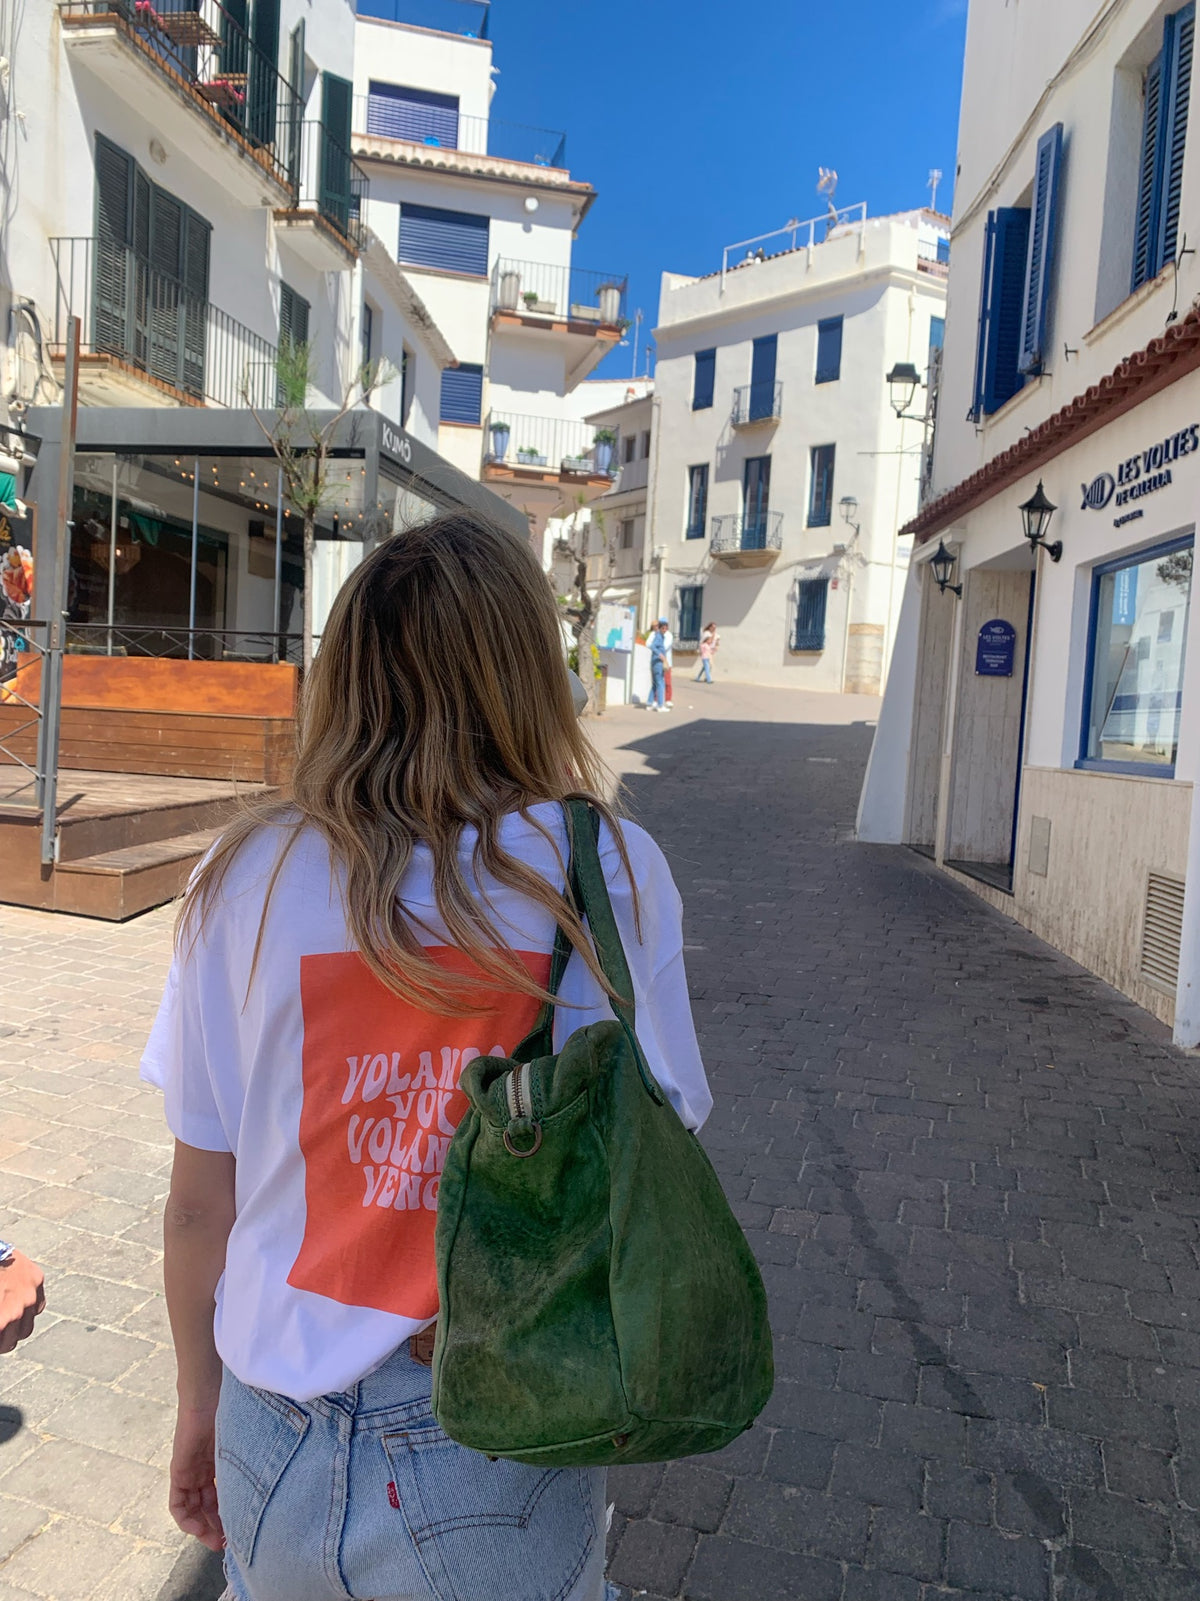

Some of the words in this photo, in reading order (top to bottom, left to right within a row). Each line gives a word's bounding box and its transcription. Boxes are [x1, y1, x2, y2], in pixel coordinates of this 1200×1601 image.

[1117, 454, 1141, 487] LES
[1142, 423, 1200, 474] VOLTES
[1115, 489, 1129, 506] DE
[341, 1044, 506, 1105] VOLAN
[347, 1113, 452, 1174] VOLAN
[362, 1165, 441, 1212] VENG
